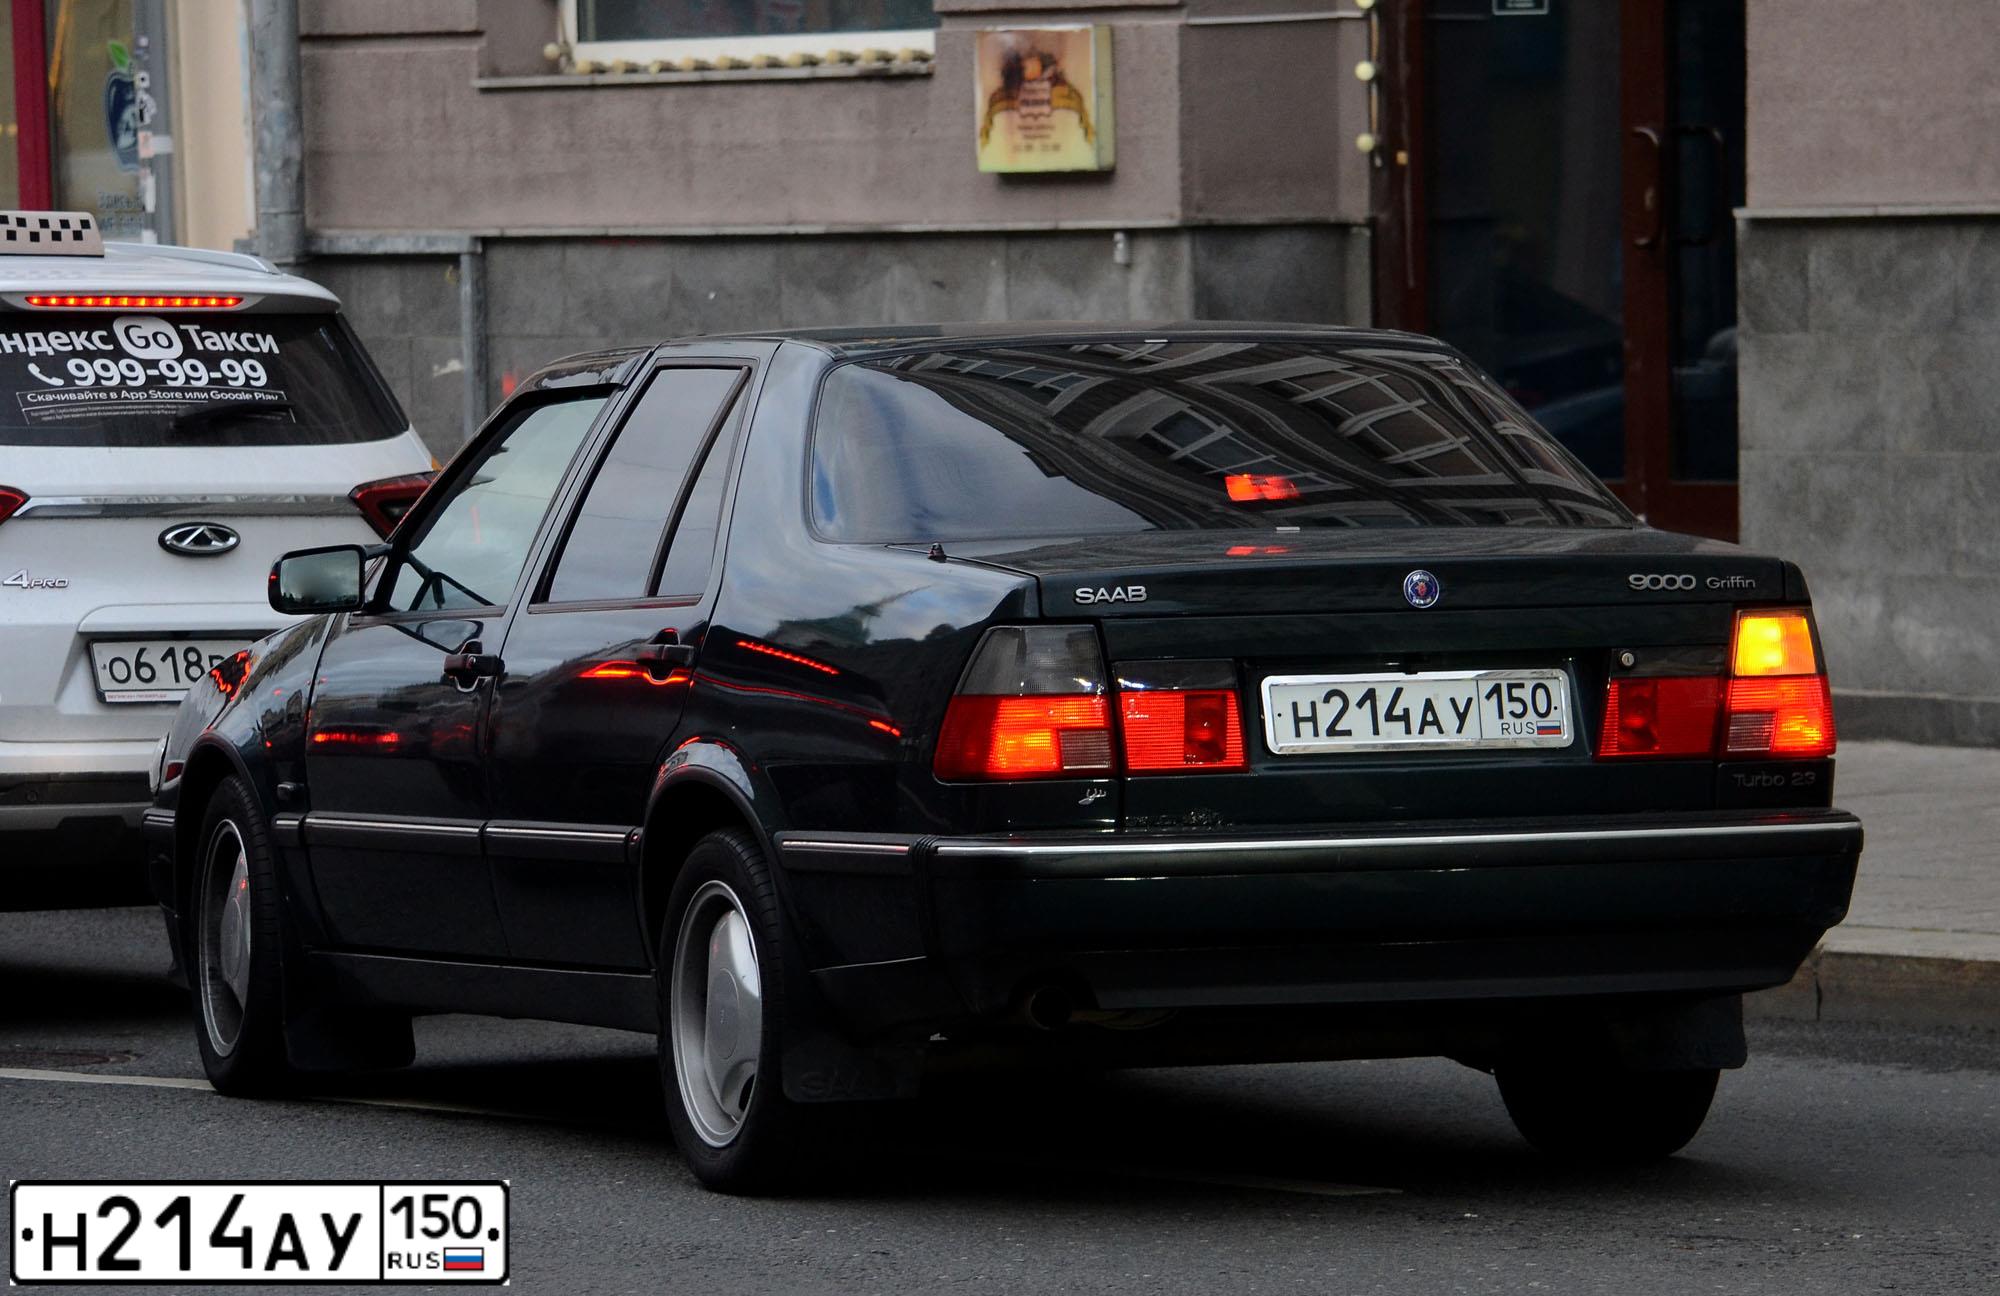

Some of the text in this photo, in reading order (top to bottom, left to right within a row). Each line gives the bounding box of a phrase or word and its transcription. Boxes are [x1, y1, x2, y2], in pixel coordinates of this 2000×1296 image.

[0, 324, 280, 357] ндекс Go Такси
[67, 358, 268, 387] 999-99-99
[27, 390, 279, 403] Скачивайте в App Store или Google Play
[1628, 573, 1756, 591] 9000 Griffin
[1074, 585, 1148, 605] SAAB
[1291, 682, 1552, 738] Н214АУ 150
[1501, 721, 1535, 736] RUS
[1733, 771, 1785, 787] Turbo
